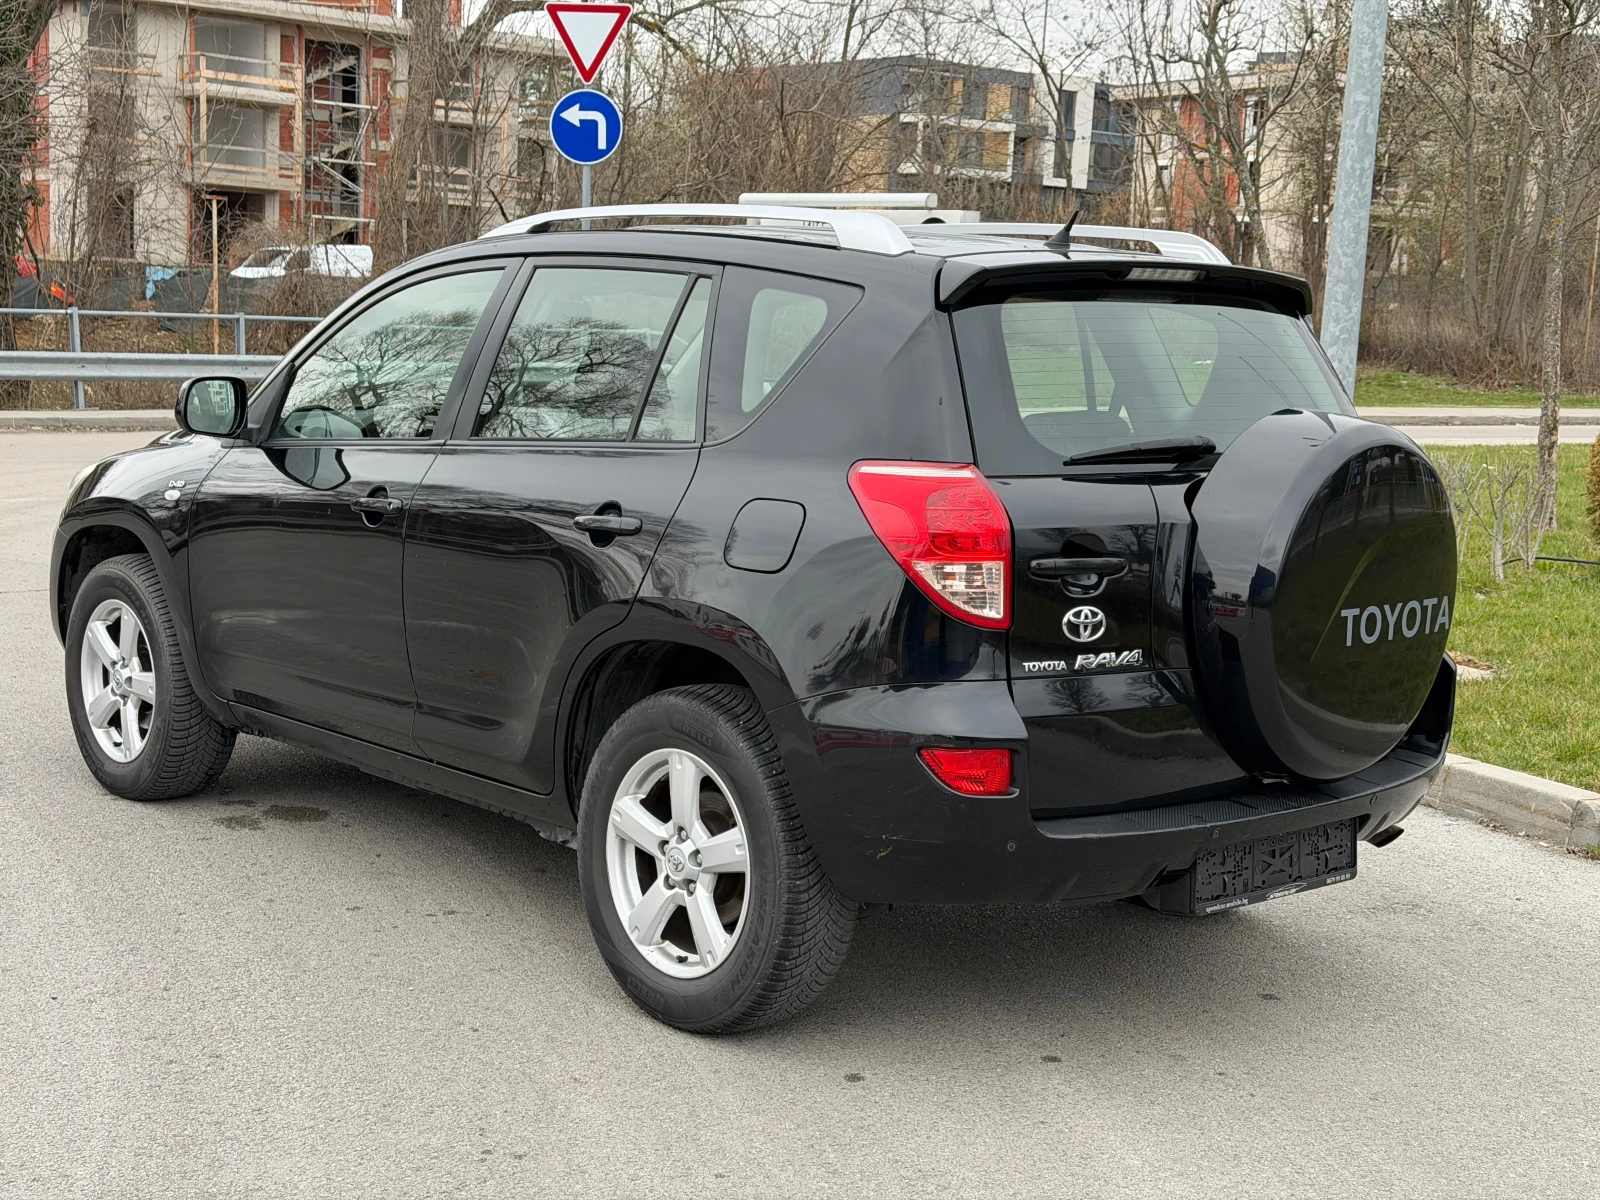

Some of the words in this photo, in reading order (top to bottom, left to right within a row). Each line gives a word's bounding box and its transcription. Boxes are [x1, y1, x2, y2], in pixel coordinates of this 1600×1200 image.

[1341, 595, 1450, 647] TOYOTA
[1022, 660, 1067, 673] TOYOTA
[1074, 649, 1143, 670] RAV4
[730, 894, 768, 993] SEASON
